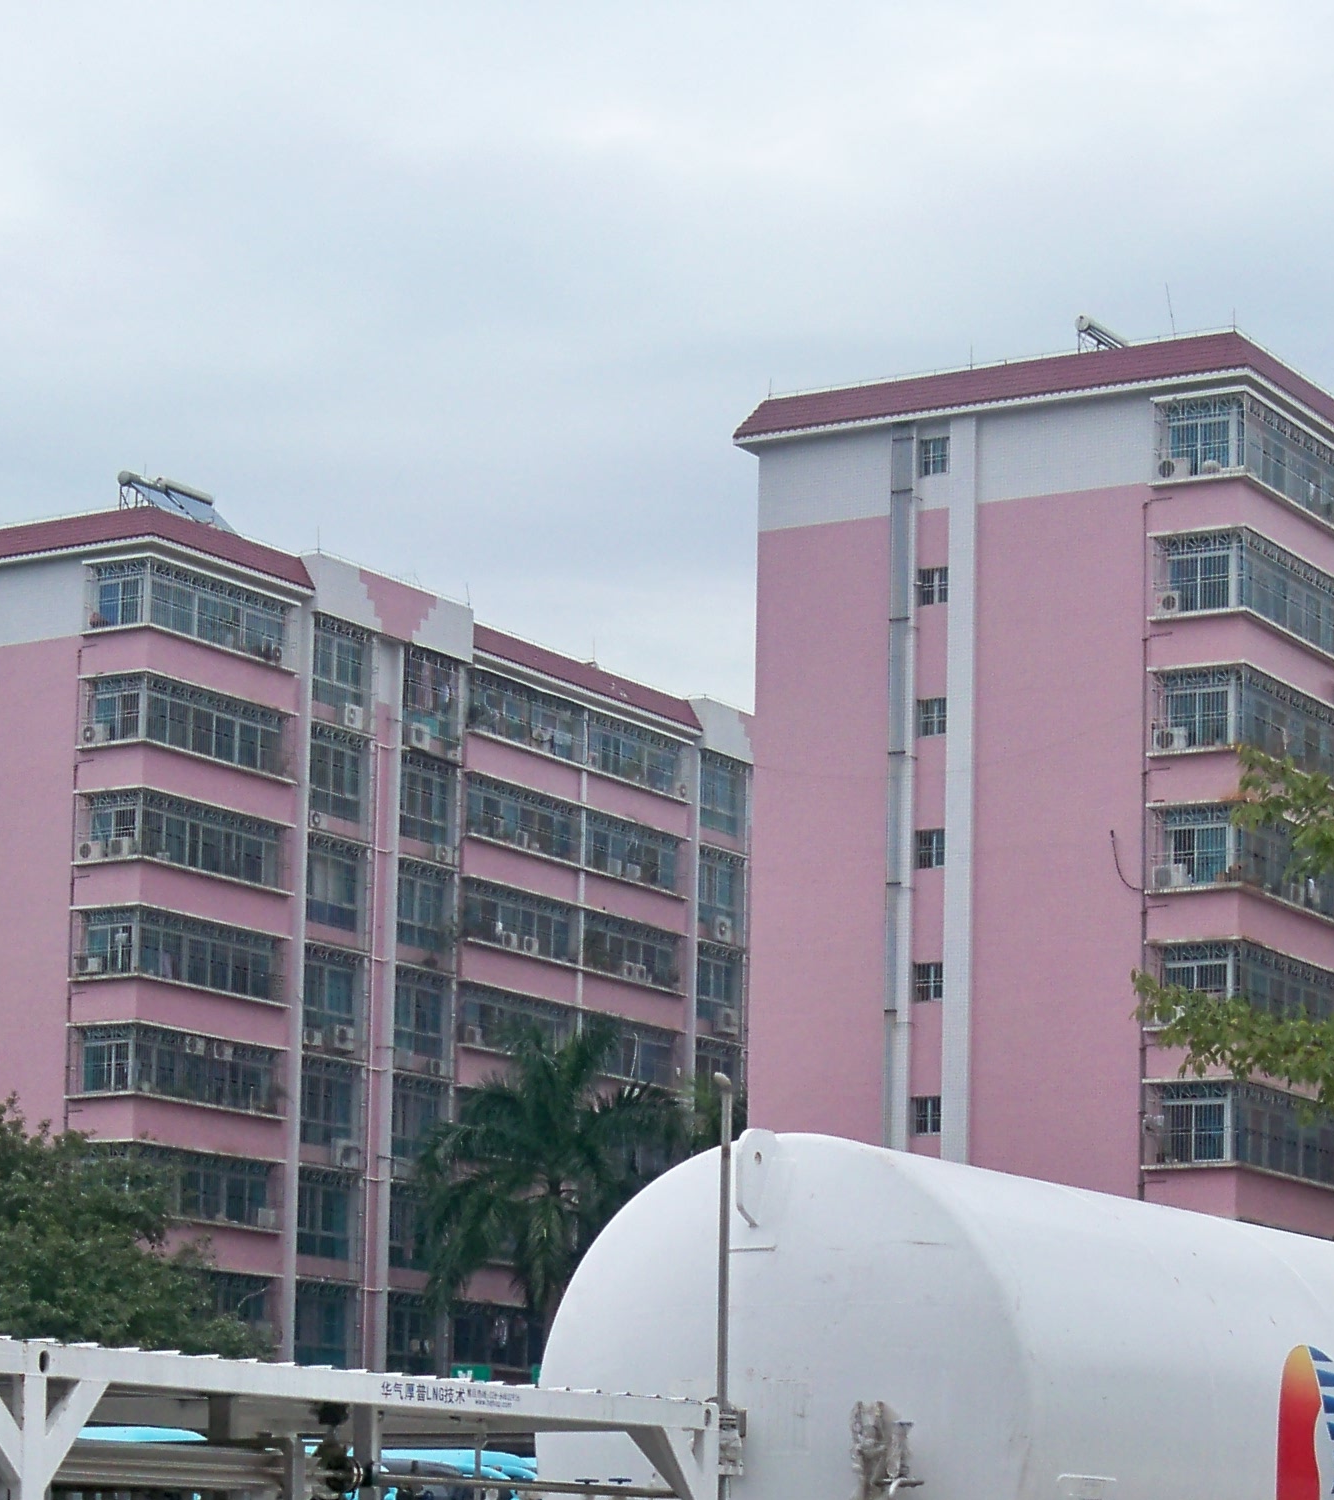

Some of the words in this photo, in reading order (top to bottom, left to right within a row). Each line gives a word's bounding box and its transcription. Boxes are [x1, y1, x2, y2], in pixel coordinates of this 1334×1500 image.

[381, 1381, 466, 1404] 华气厚普LNG技术
